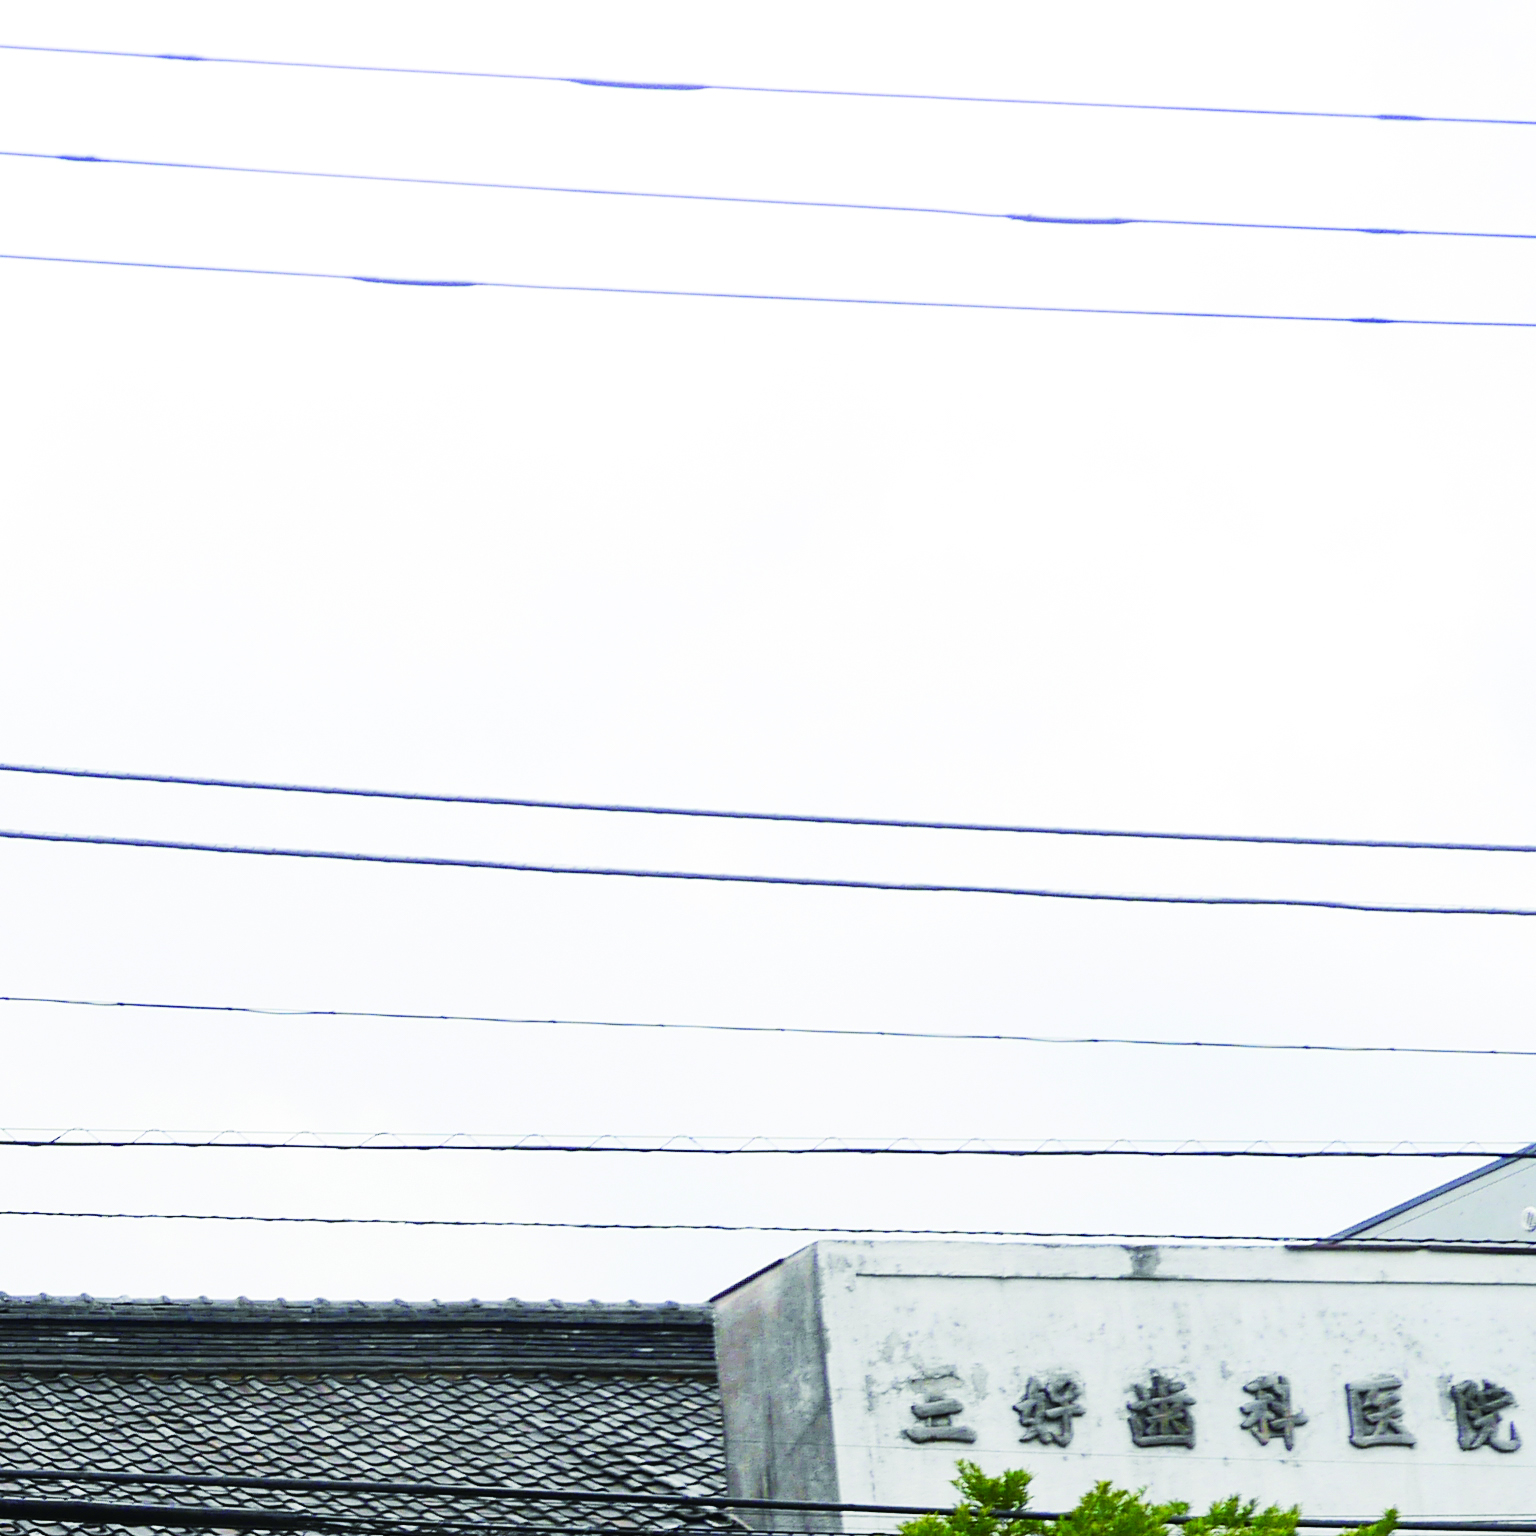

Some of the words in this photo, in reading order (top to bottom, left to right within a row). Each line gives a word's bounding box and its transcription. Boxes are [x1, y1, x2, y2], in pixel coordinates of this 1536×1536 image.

[901, 1366, 1523, 1453] 三好歯科医院
